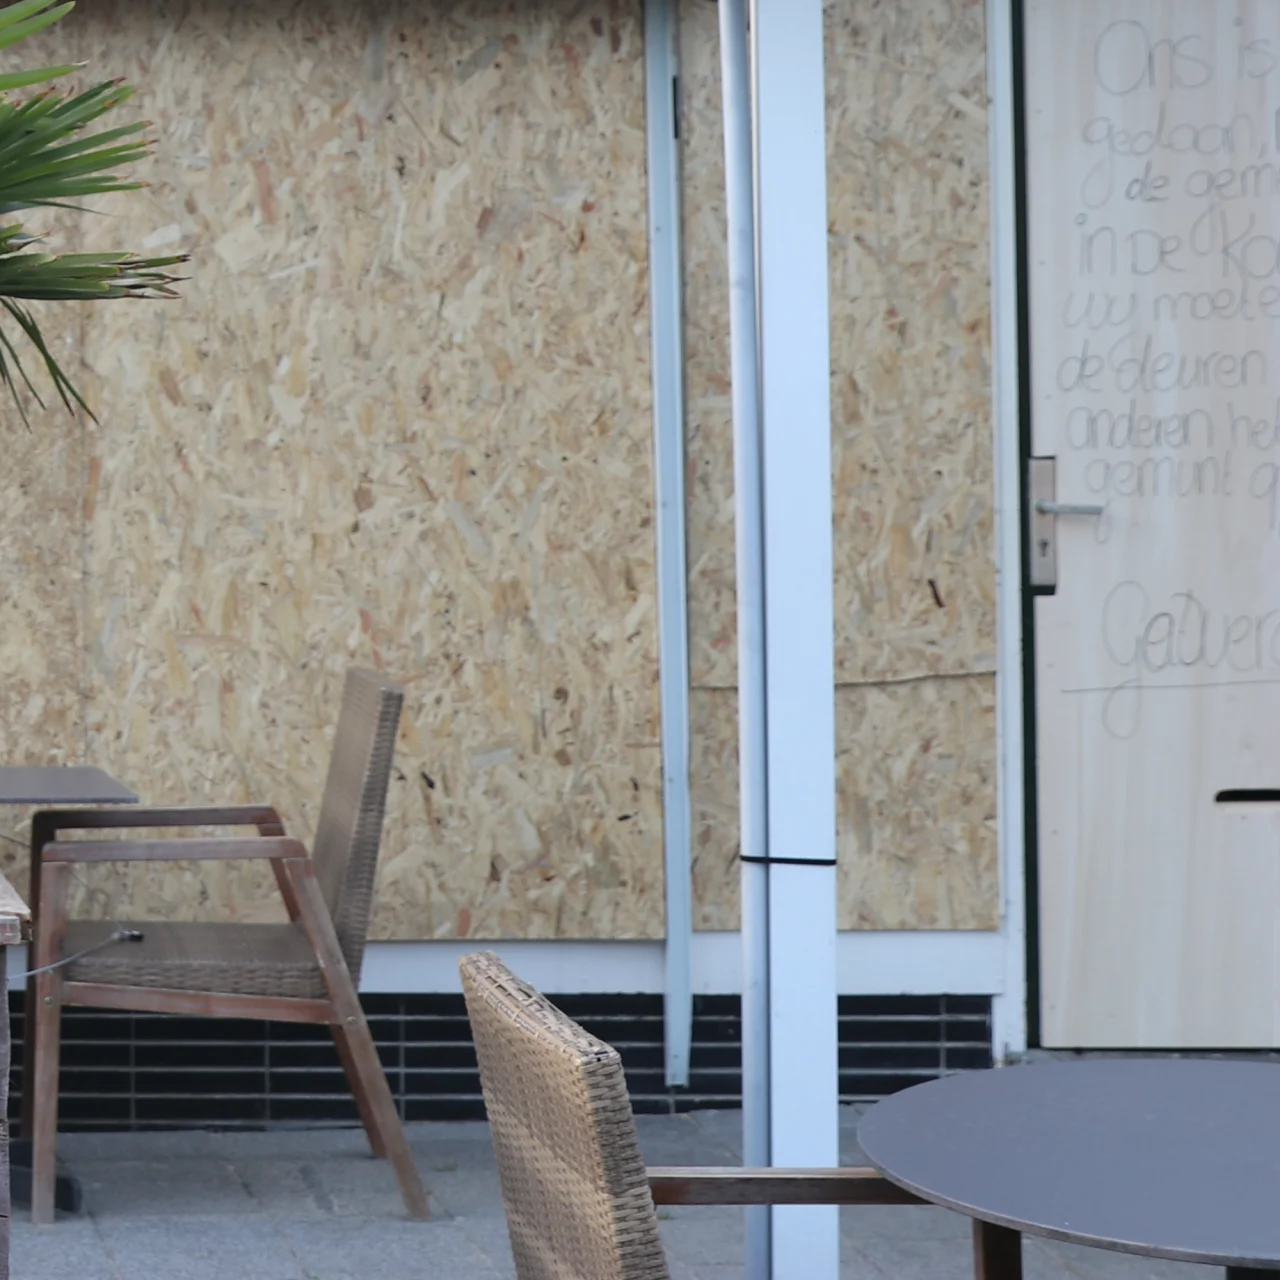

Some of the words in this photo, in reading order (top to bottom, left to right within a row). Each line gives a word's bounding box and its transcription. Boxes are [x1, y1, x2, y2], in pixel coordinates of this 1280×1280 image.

[1093, 19, 1215, 95] Ons
[1233, 16, 1278, 81] is
[1124, 160, 1170, 202] de
[1073, 212, 1117, 278] in
[1056, 337, 1105, 392] de
[1065, 398, 1214, 450] anderen
